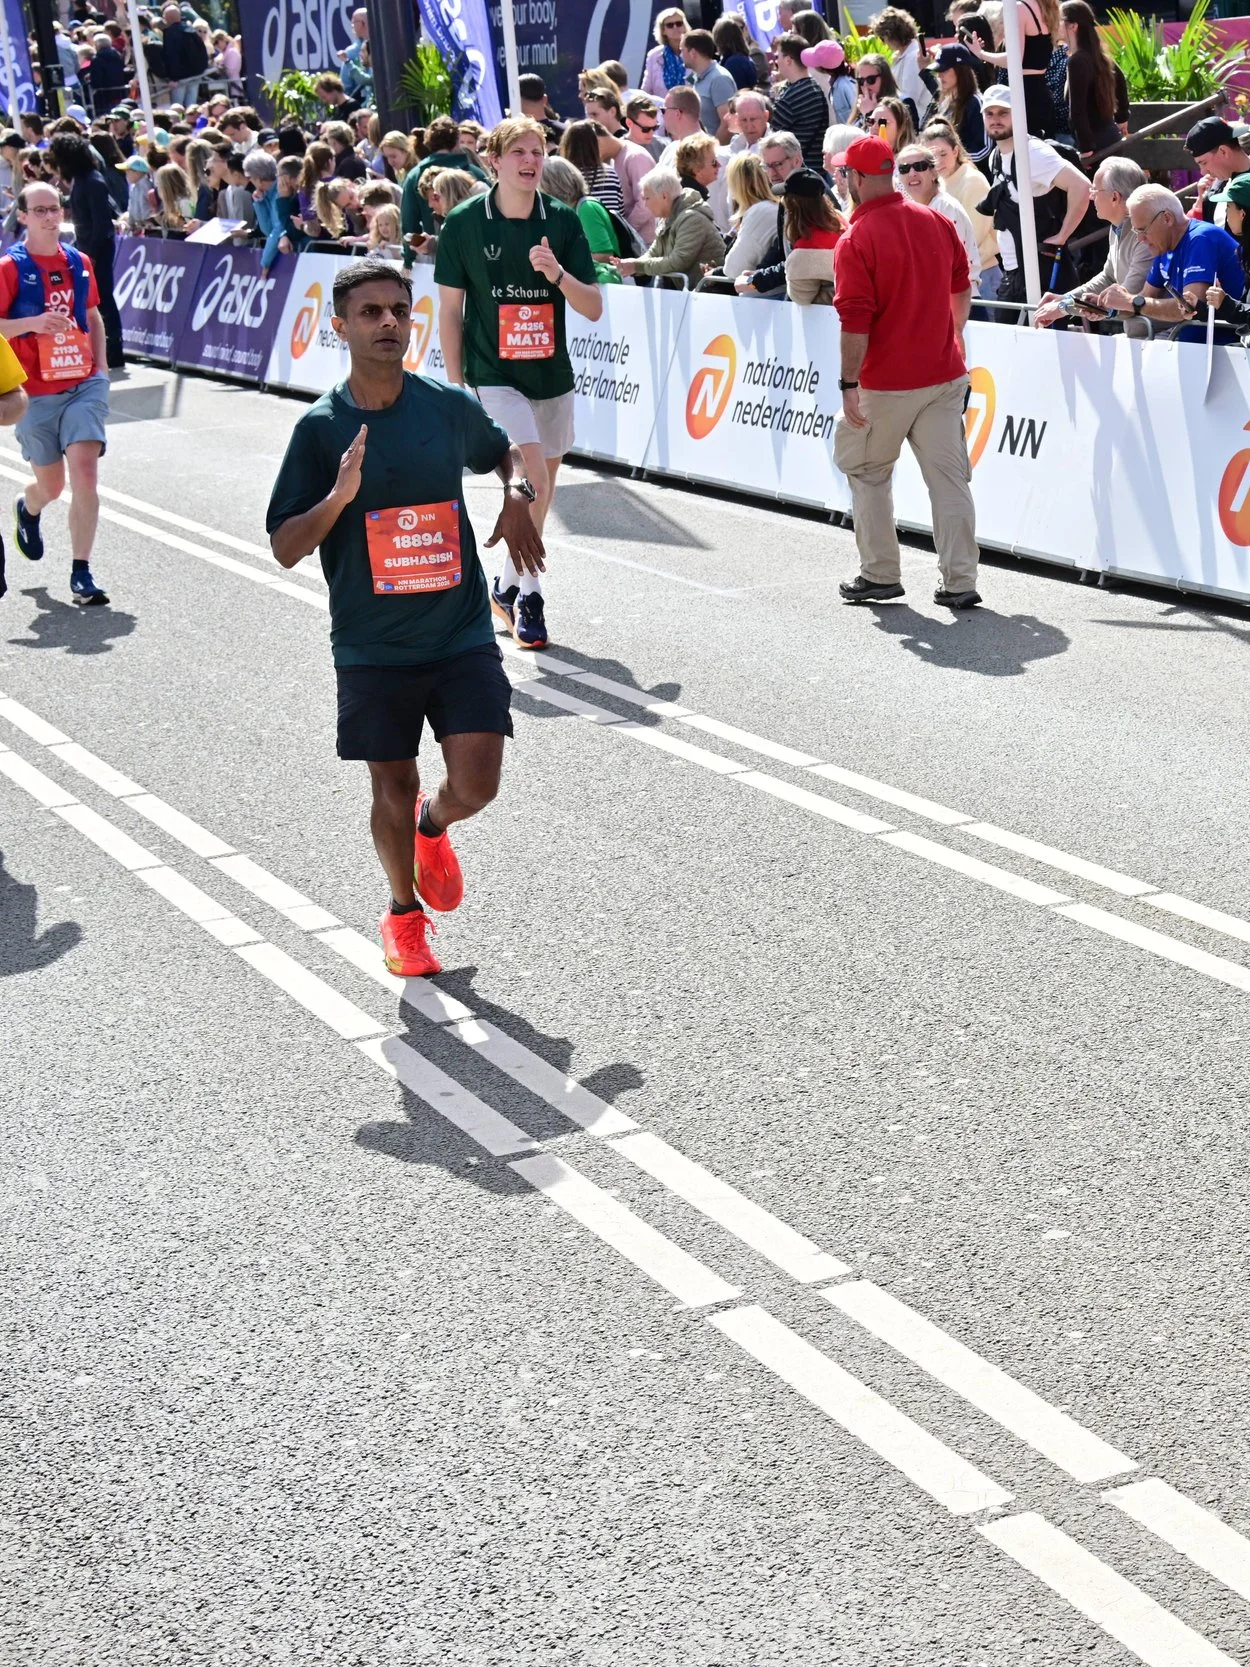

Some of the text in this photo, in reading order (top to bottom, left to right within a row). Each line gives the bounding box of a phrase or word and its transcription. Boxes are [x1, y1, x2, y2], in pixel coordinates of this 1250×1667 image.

[531, 33, 558, 65] mind
[131, 262, 186, 314] asics
[217, 273, 277, 329] asics
[506, 332, 550, 346] MATS
[513, 321, 545, 332] 24256
[50, 354, 84, 368] MAX
[569, 332, 630, 365] nationale
[574, 366, 640, 405] derlanden
[742, 356, 820, 394] nationale
[731, 395, 834, 440] nederlanden
[997, 414, 1048, 460] NN
[420, 512, 436, 522] NN
[392, 531, 444, 549] 18894
[384, 551, 454, 569] SUBHASISH
[408, 575, 447, 586] MARATHON
